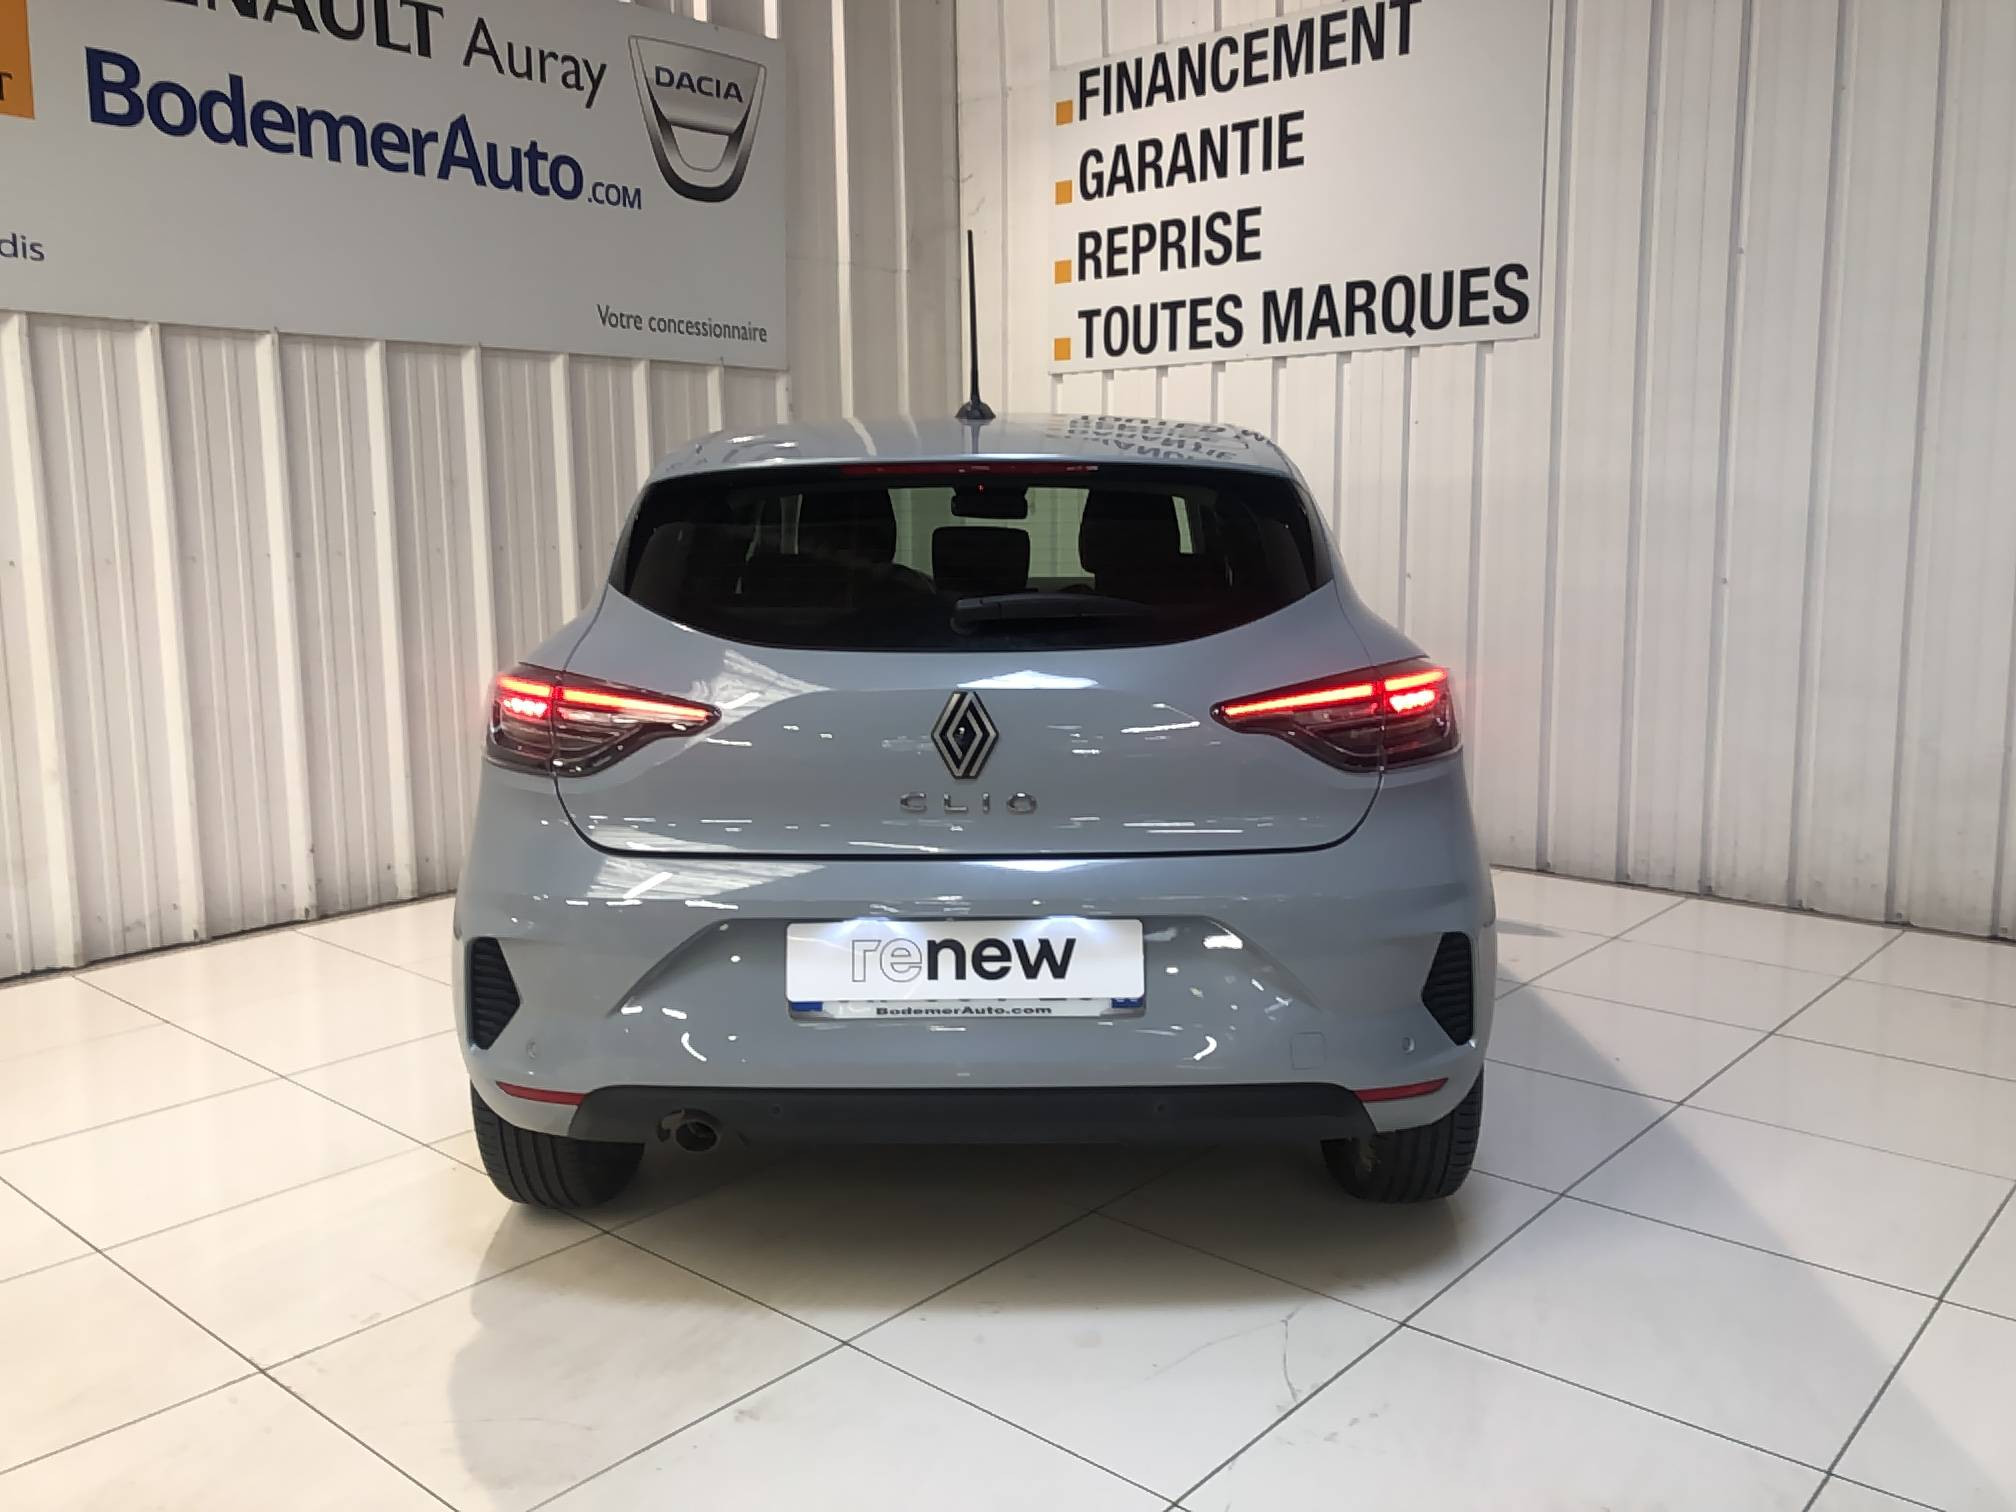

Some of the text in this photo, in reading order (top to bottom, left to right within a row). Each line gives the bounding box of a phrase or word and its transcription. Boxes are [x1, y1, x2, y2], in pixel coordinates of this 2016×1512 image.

[160, 0, 607, 109] AULT Auray
[654, 65, 744, 104] DACIA
[1078, 0, 1422, 122] FINANCEMENT
[1079, 110, 1305, 202] GARANTIE
[1077, 206, 1262, 282] REPRISE
[597, 304, 768, 343] Votre concessionnaire
[1078, 263, 1530, 359] TOUTES MARQUES
[900, 792, 1038, 814] CLIO
[851, 938, 1076, 983] renew
[875, 1006, 1053, 1016] BodemerAuto.com
